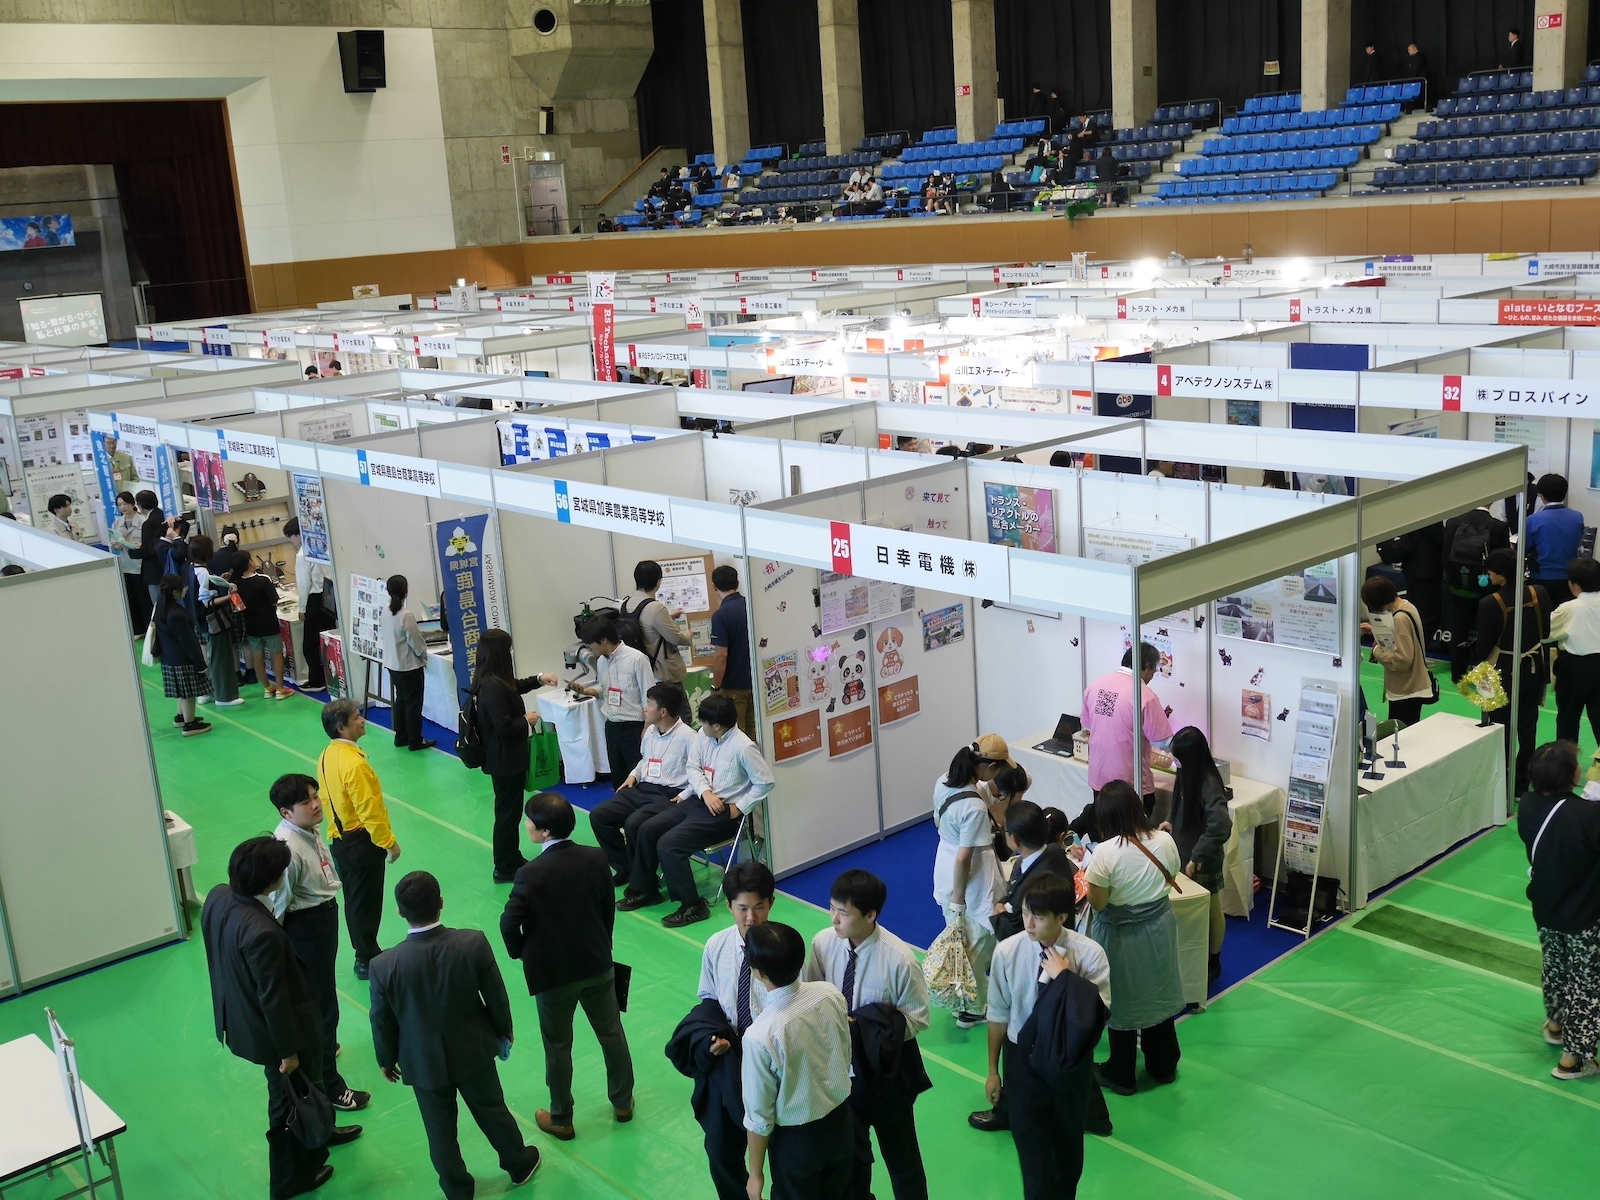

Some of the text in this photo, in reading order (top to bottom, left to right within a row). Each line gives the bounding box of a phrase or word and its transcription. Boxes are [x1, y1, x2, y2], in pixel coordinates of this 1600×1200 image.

[1117, 304, 1127, 314] 24
[1290, 305, 1300, 315] 24
[630, 351, 635, 360] 1
[1160, 374, 1168, 387] 4
[1175, 375, 1274, 392] アベテクノシステム㈱
[1117, 395, 1132, 405] abe
[1444, 386, 1460, 400] 32
[1476, 387, 1588, 405] ㈱プロスパイン
[227, 440, 276, 459] 宮城県古川工業高等学校
[370, 463, 436, 485] 宮城県鹿島台商業高等学校
[556, 493, 568, 510] 56
[922, 491, 951, 503] 来て見て
[572, 496, 666, 527] 宮城県加美農業高等学校
[991, 505, 1039, 522] リアクトルの
[927, 518, 948, 530] 触って
[991, 518, 1041, 534] 総合メーカー
[832, 537, 850, 559] 25
[876, 545, 978, 578] 日幸電機㈱
[886, 690, 892, 700] 3
[782, 726, 788, 736] 1
[835, 724, 842, 733] 2
